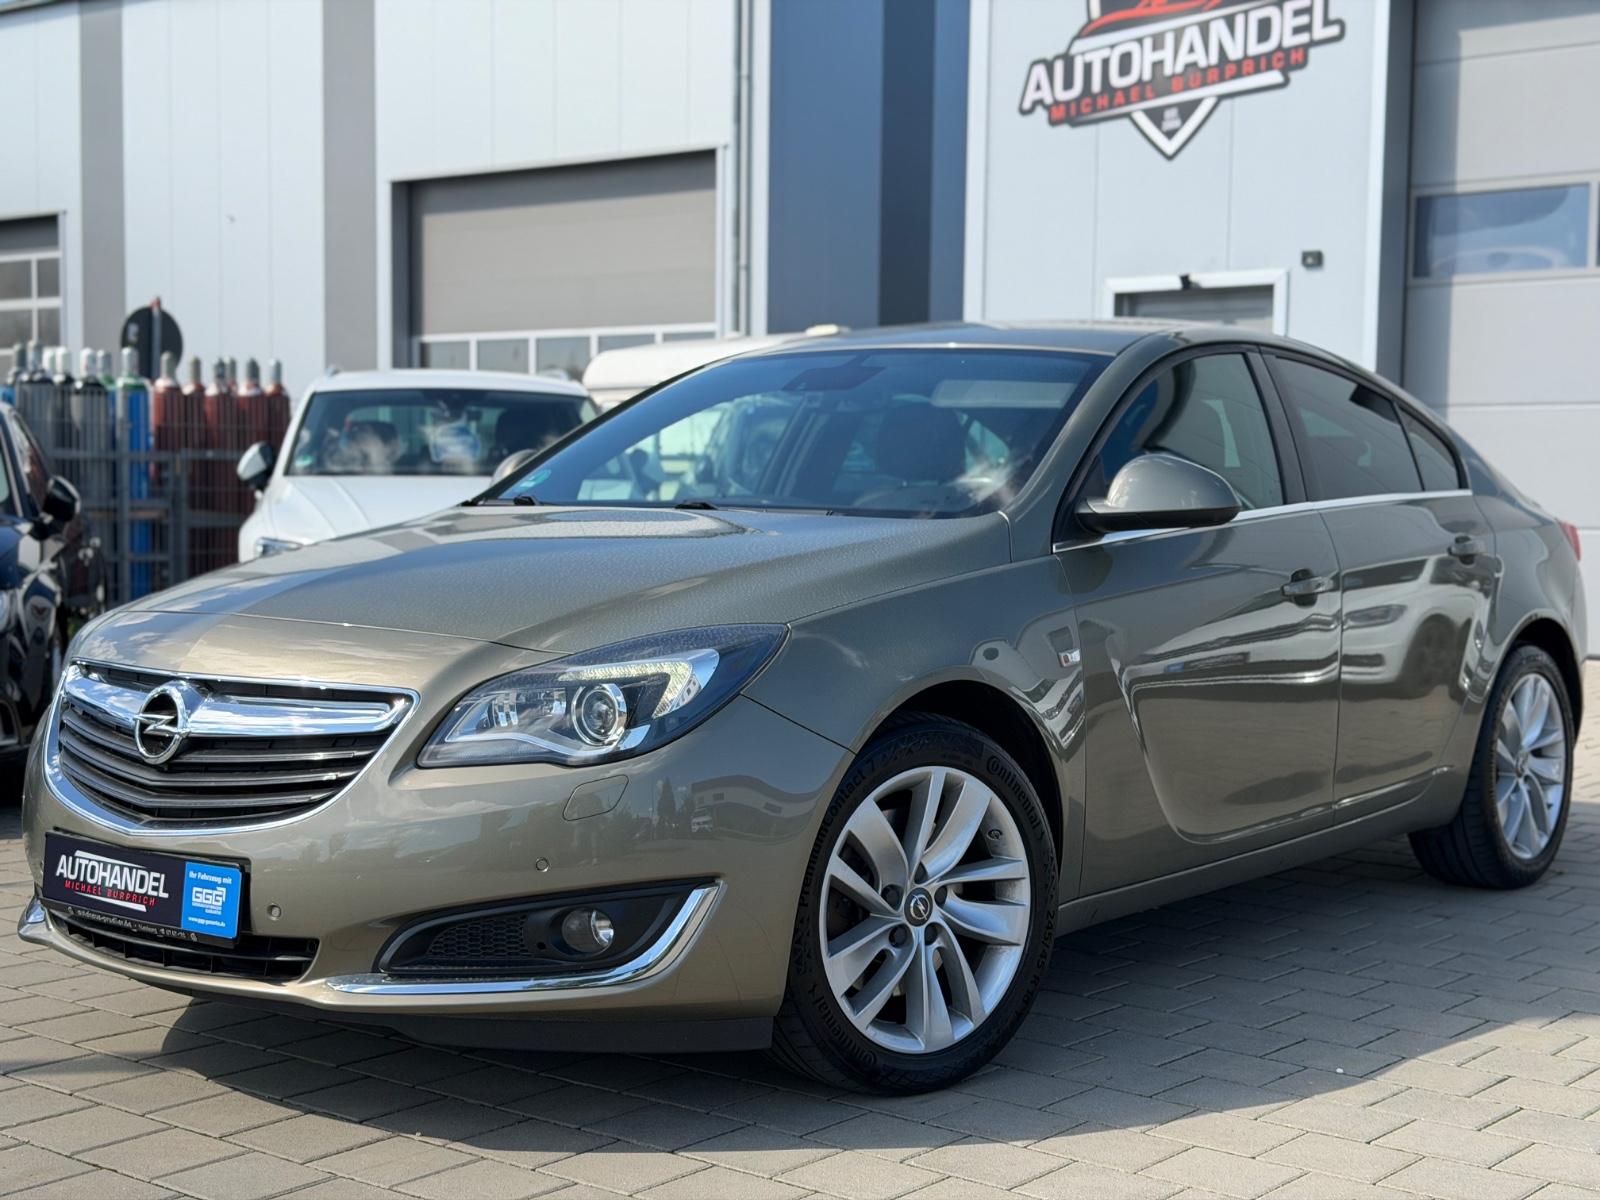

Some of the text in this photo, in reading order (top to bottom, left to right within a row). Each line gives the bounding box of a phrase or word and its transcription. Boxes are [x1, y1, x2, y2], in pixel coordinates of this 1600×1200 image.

[1021, 0, 1340, 110] AUTOHANDEL
[1050, 84, 1155, 121] MICHAEL
[56, 854, 168, 898] AUTOHANDEL
[65, 880, 102, 895] MICHAEL
